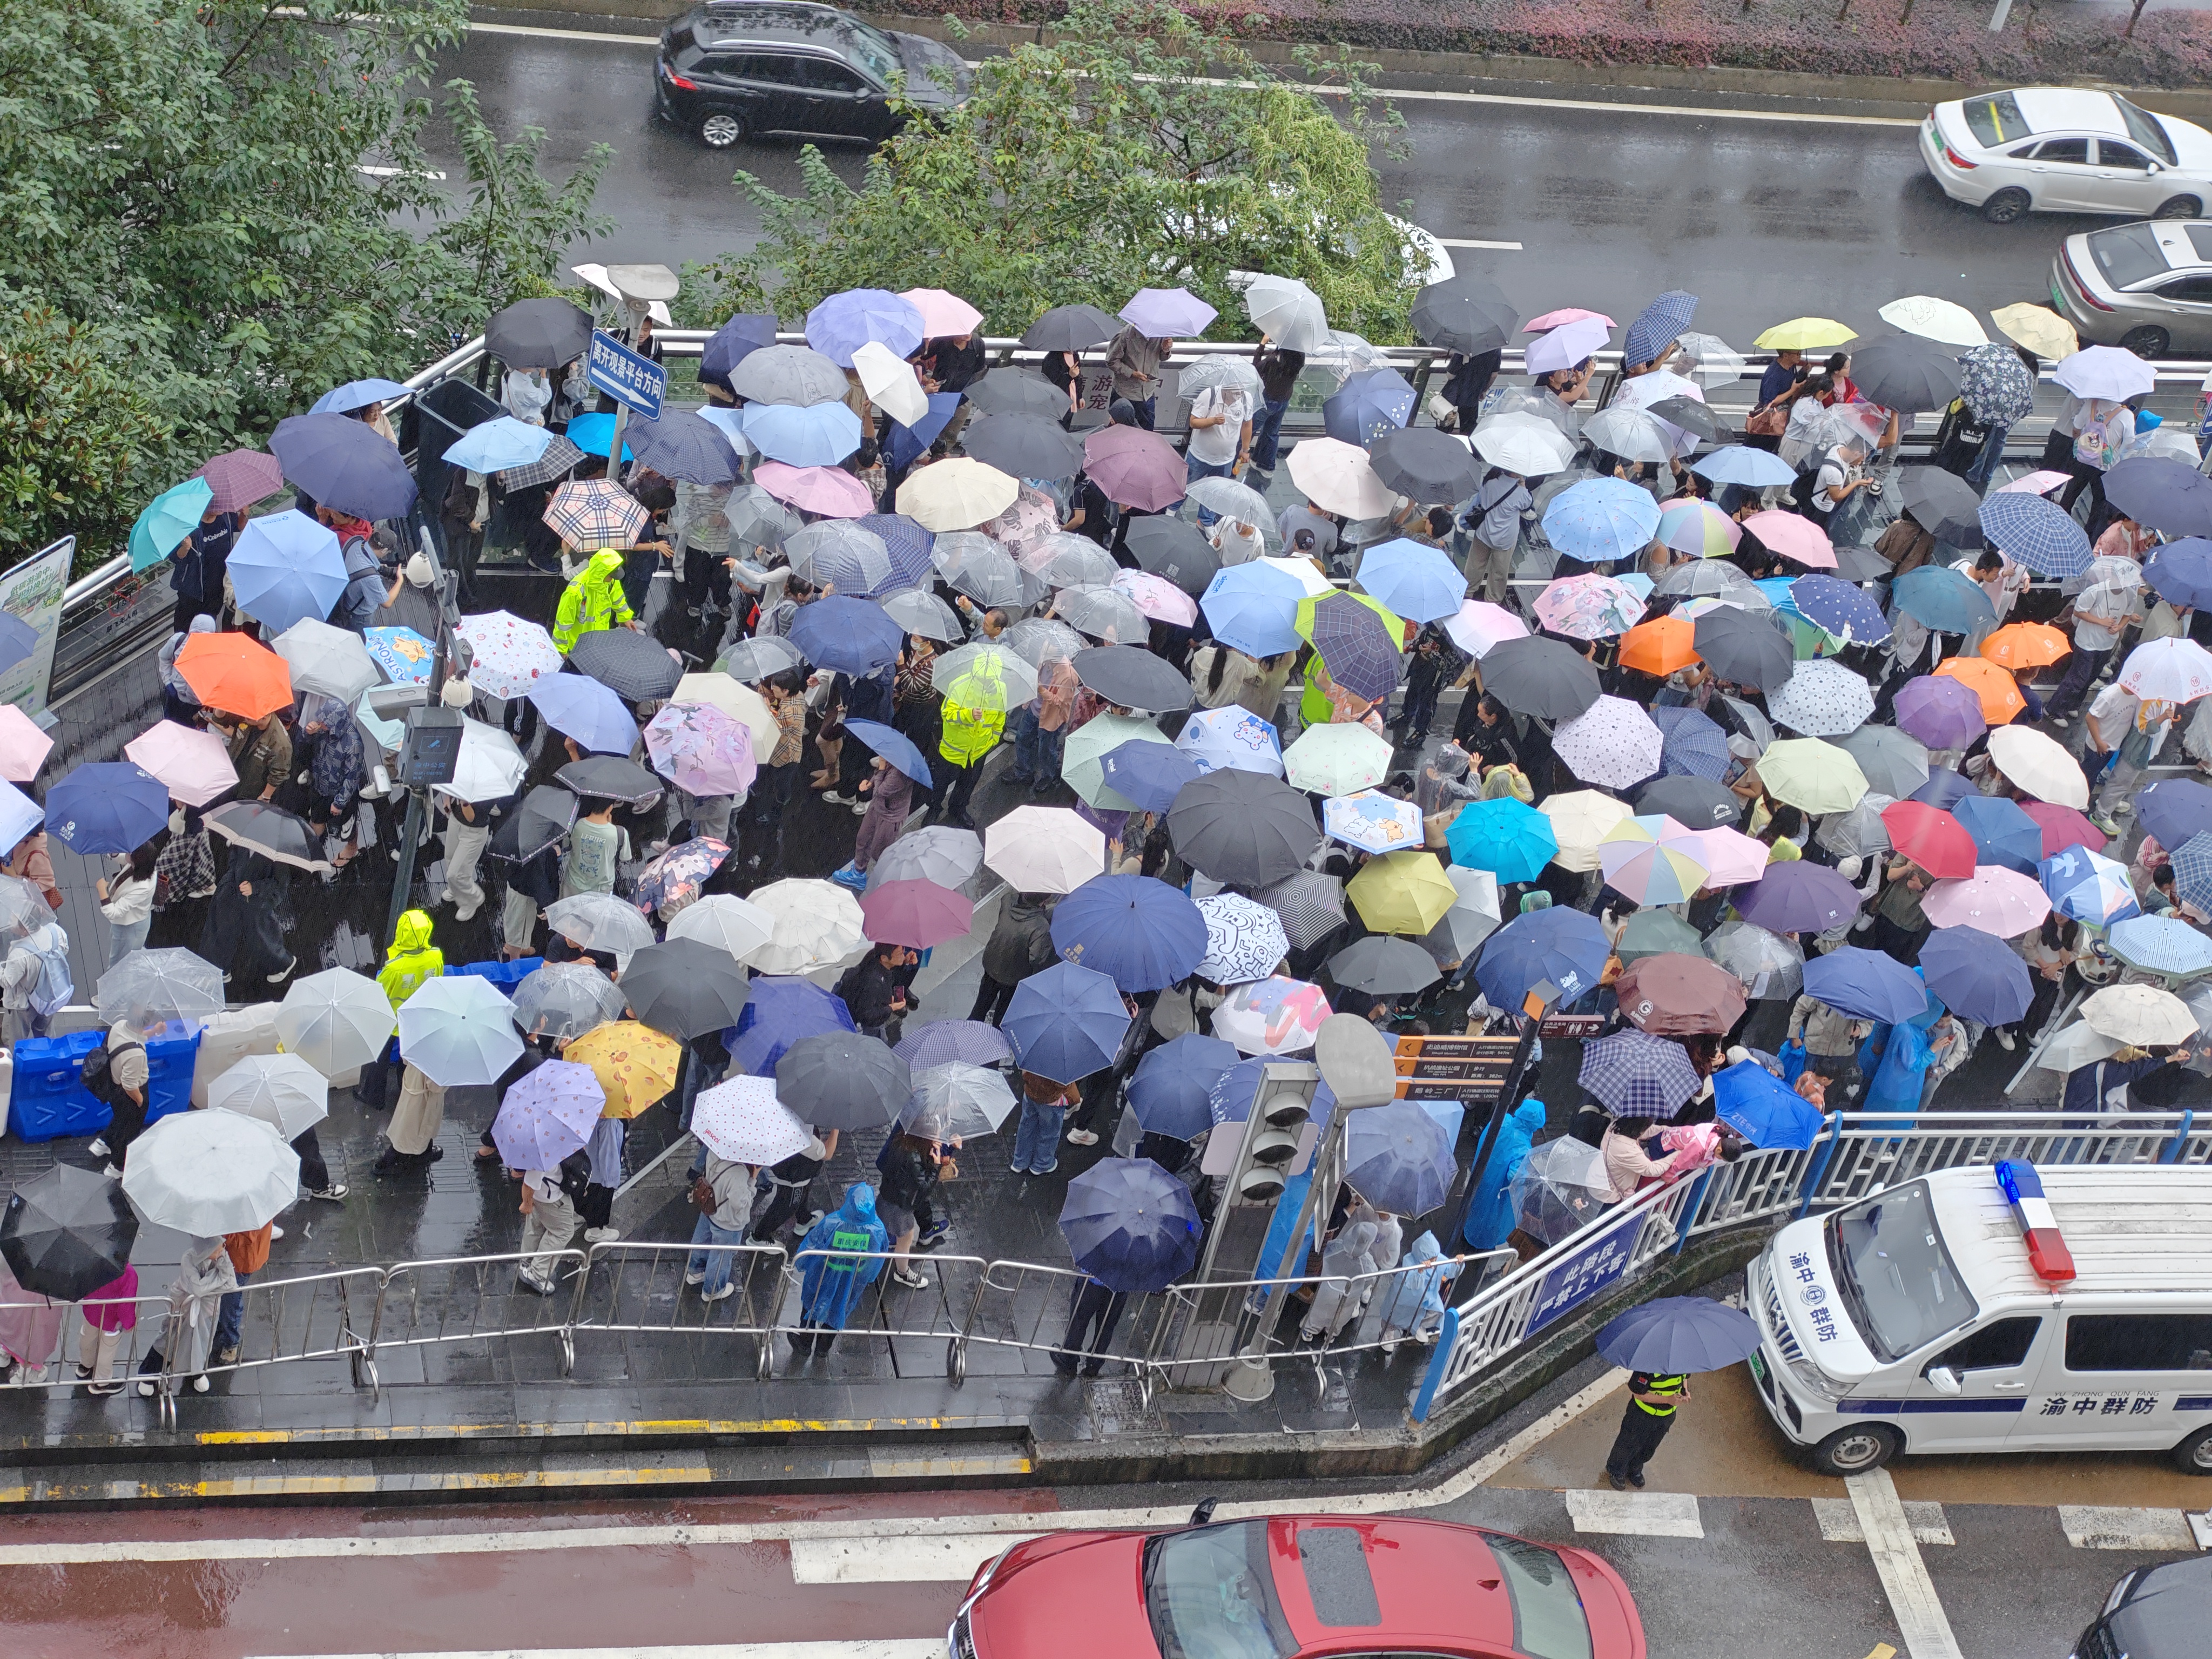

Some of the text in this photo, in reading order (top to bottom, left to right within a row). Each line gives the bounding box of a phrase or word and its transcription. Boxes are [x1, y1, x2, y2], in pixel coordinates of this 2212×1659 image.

[592, 339, 663, 400] 离开观景平台方向
[207, 529, 228, 541] Columbia
[1212, 575, 1227, 594] simon
[1534, 1250, 1627, 1322] 严禁上下客
[1561, 1239, 1617, 1287] 此路段
[1789, 1251, 1838, 1343] 渝中 群防
[2039, 1397, 2159, 1415] 渝中群防
